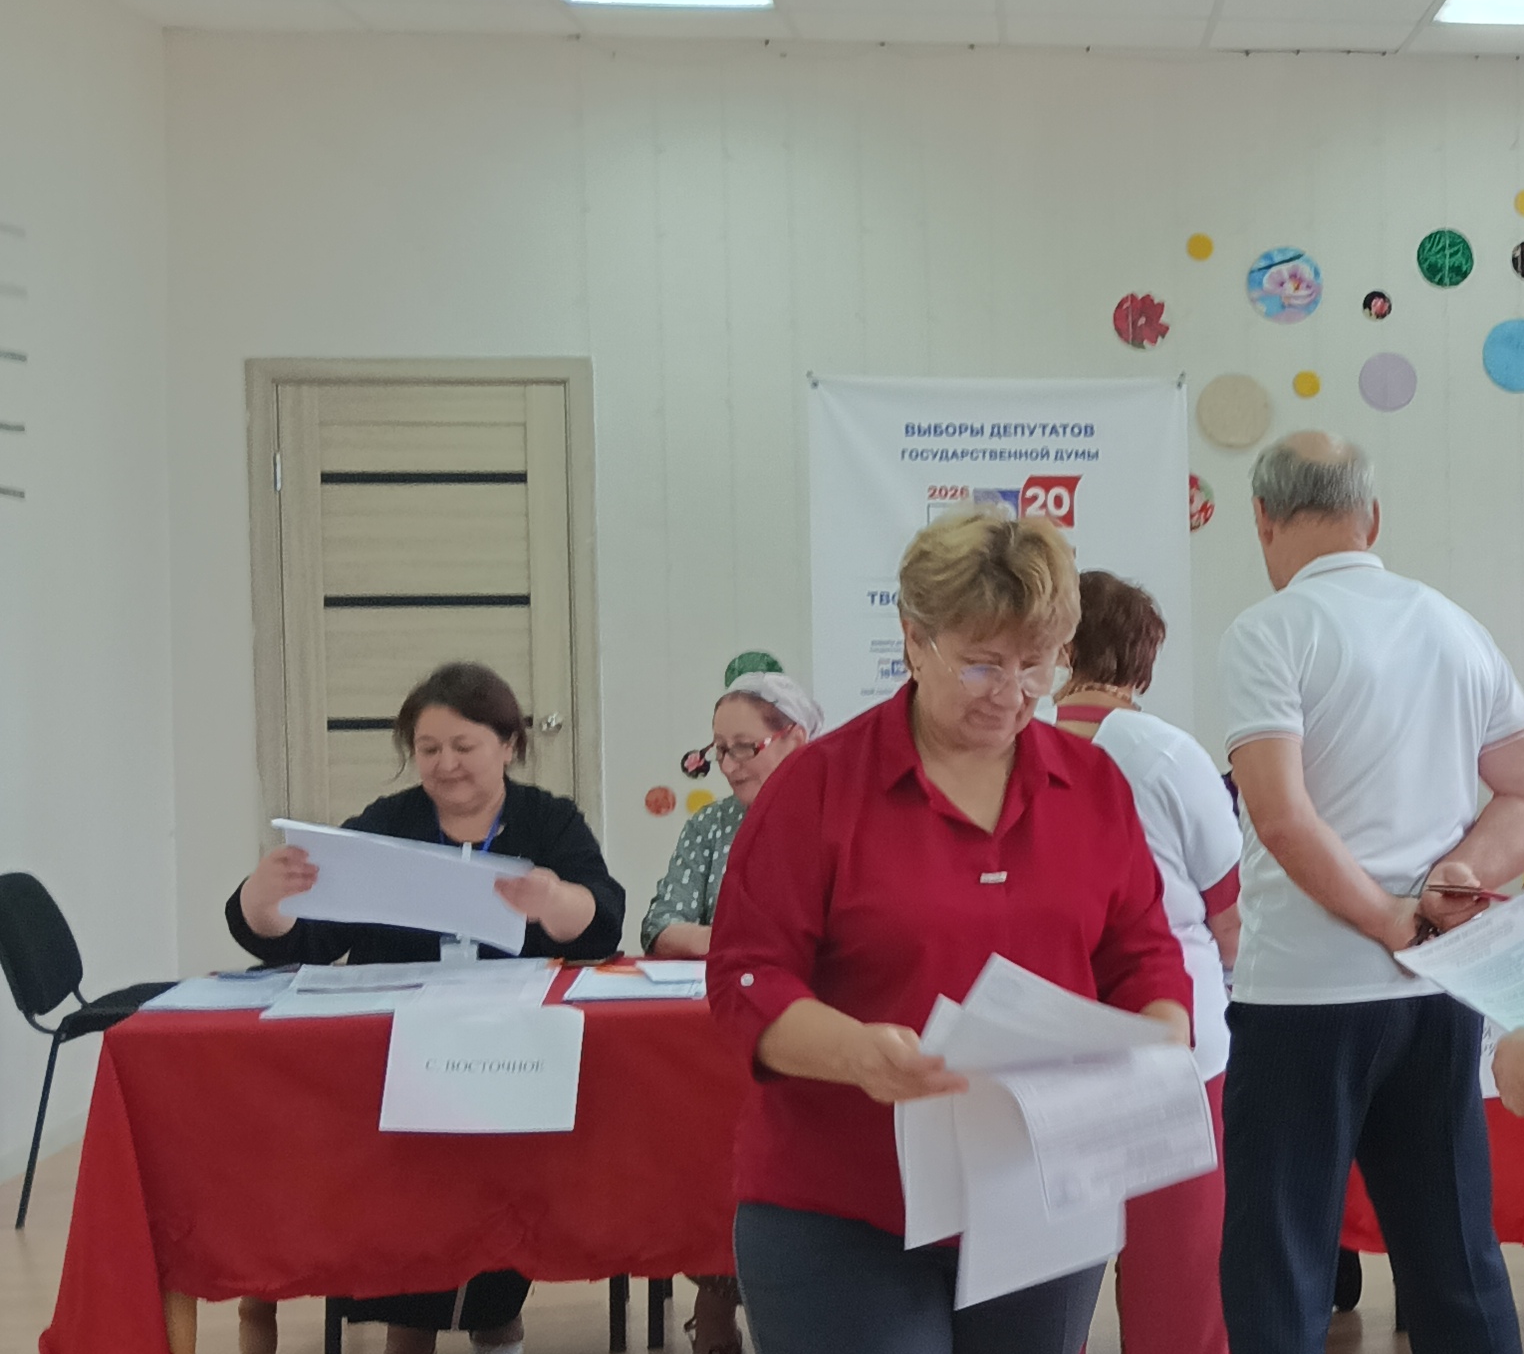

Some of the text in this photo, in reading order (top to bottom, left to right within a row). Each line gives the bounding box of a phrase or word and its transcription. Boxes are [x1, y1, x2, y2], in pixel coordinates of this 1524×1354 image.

[904, 421, 1096, 440] ВЫБОРЫ ДЕПУТАТОВ
[901, 446, 1100, 463] ГОСУДАРСТВЕННОЙ ДУМЫ
[927, 484, 971, 501] 2026
[1023, 485, 1072, 518] 20
